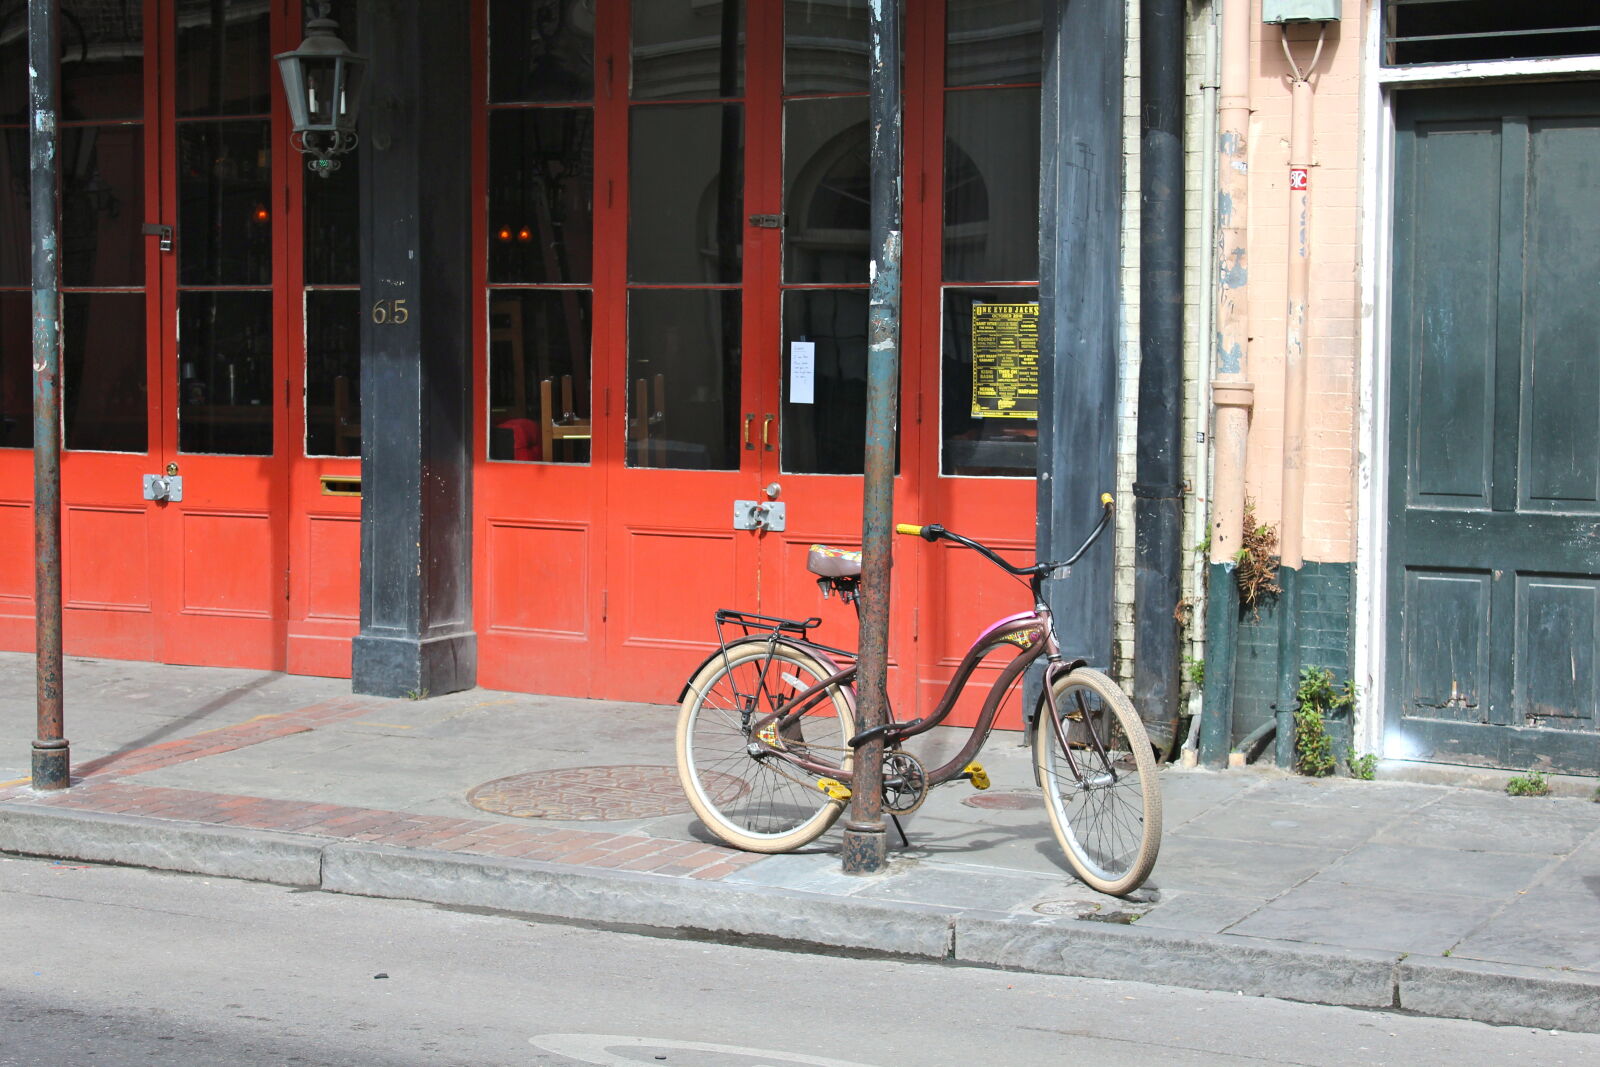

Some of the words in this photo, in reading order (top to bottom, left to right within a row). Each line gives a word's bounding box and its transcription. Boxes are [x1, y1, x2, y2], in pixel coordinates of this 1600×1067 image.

[372, 299, 409, 324] 615
[976, 306, 992, 316] ONE
[1015, 306, 1039, 316] JACKS
